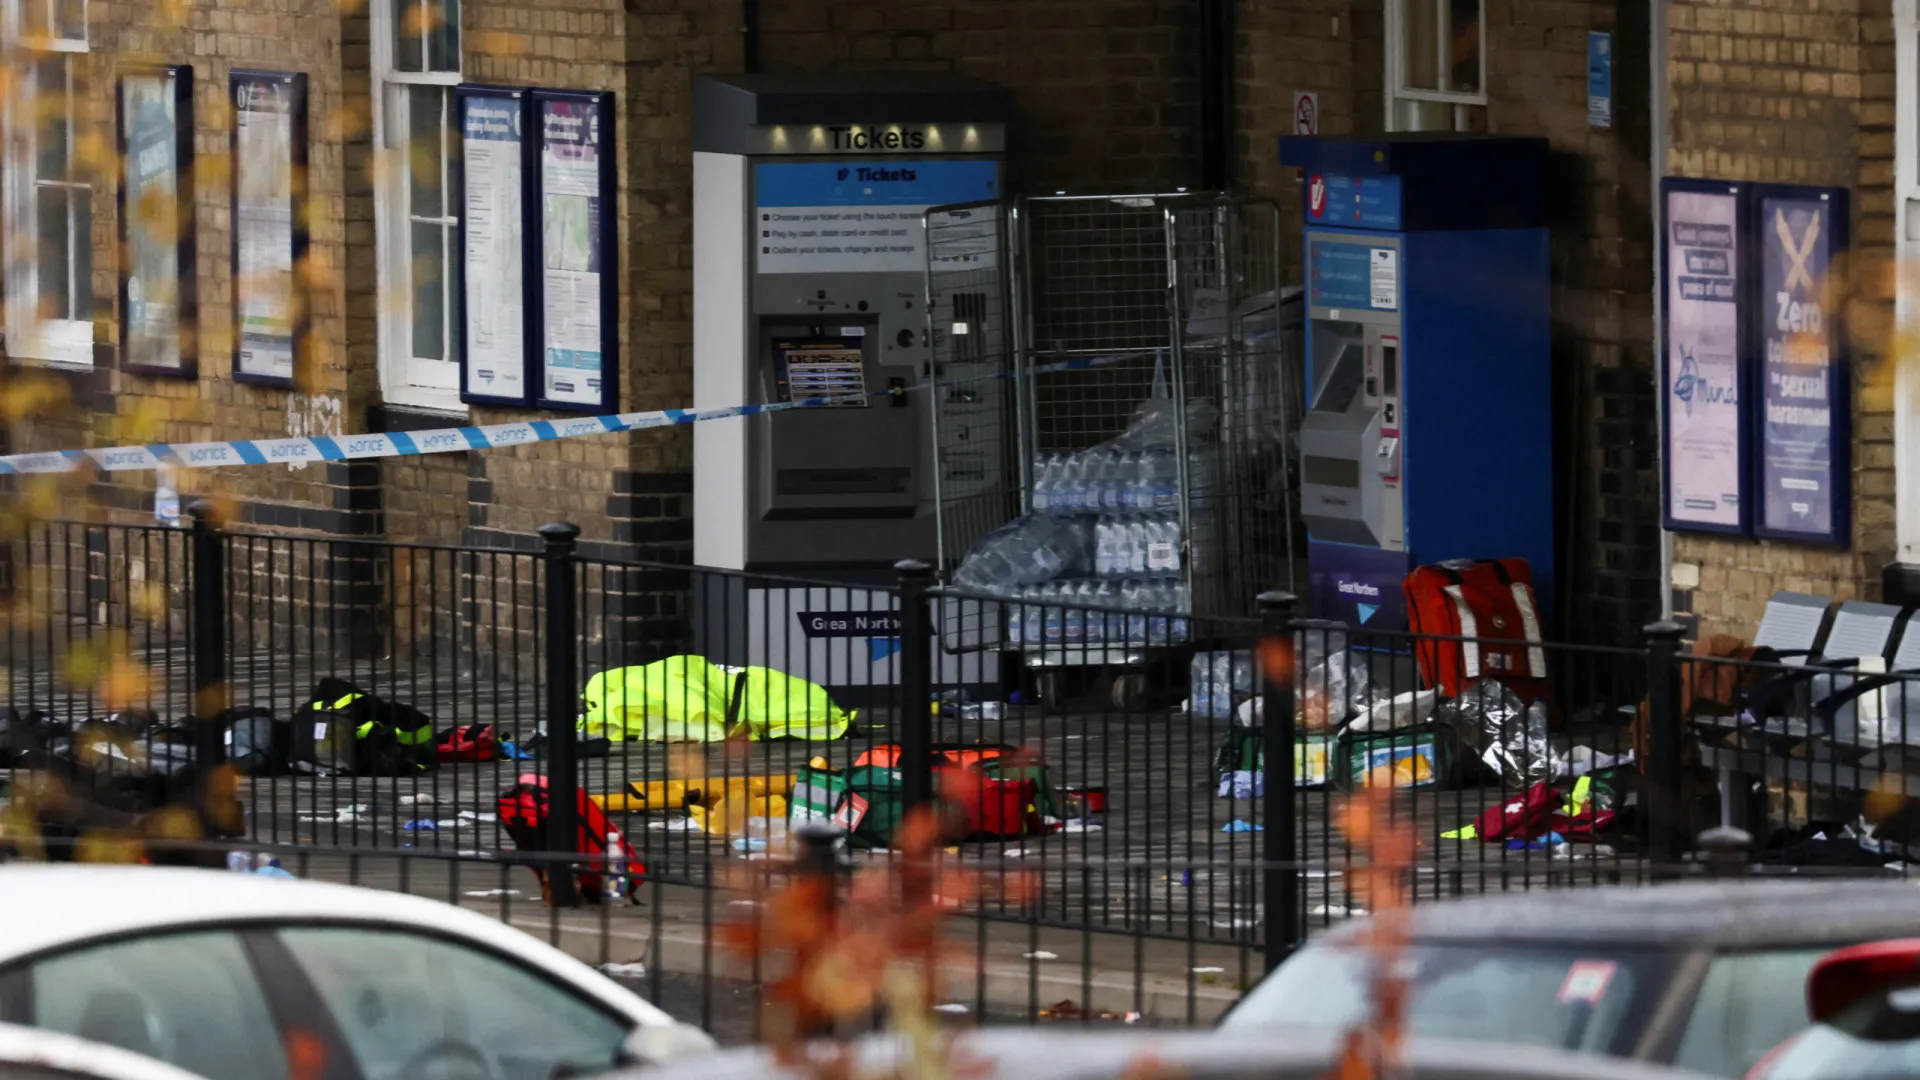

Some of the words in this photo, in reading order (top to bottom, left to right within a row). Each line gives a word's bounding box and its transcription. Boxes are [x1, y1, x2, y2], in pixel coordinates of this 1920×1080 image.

[828, 126, 925, 150] Tickets
[856, 167, 917, 182] Tickets
[1776, 291, 1822, 333] Zero
[1780, 369, 1826, 400] sexual
